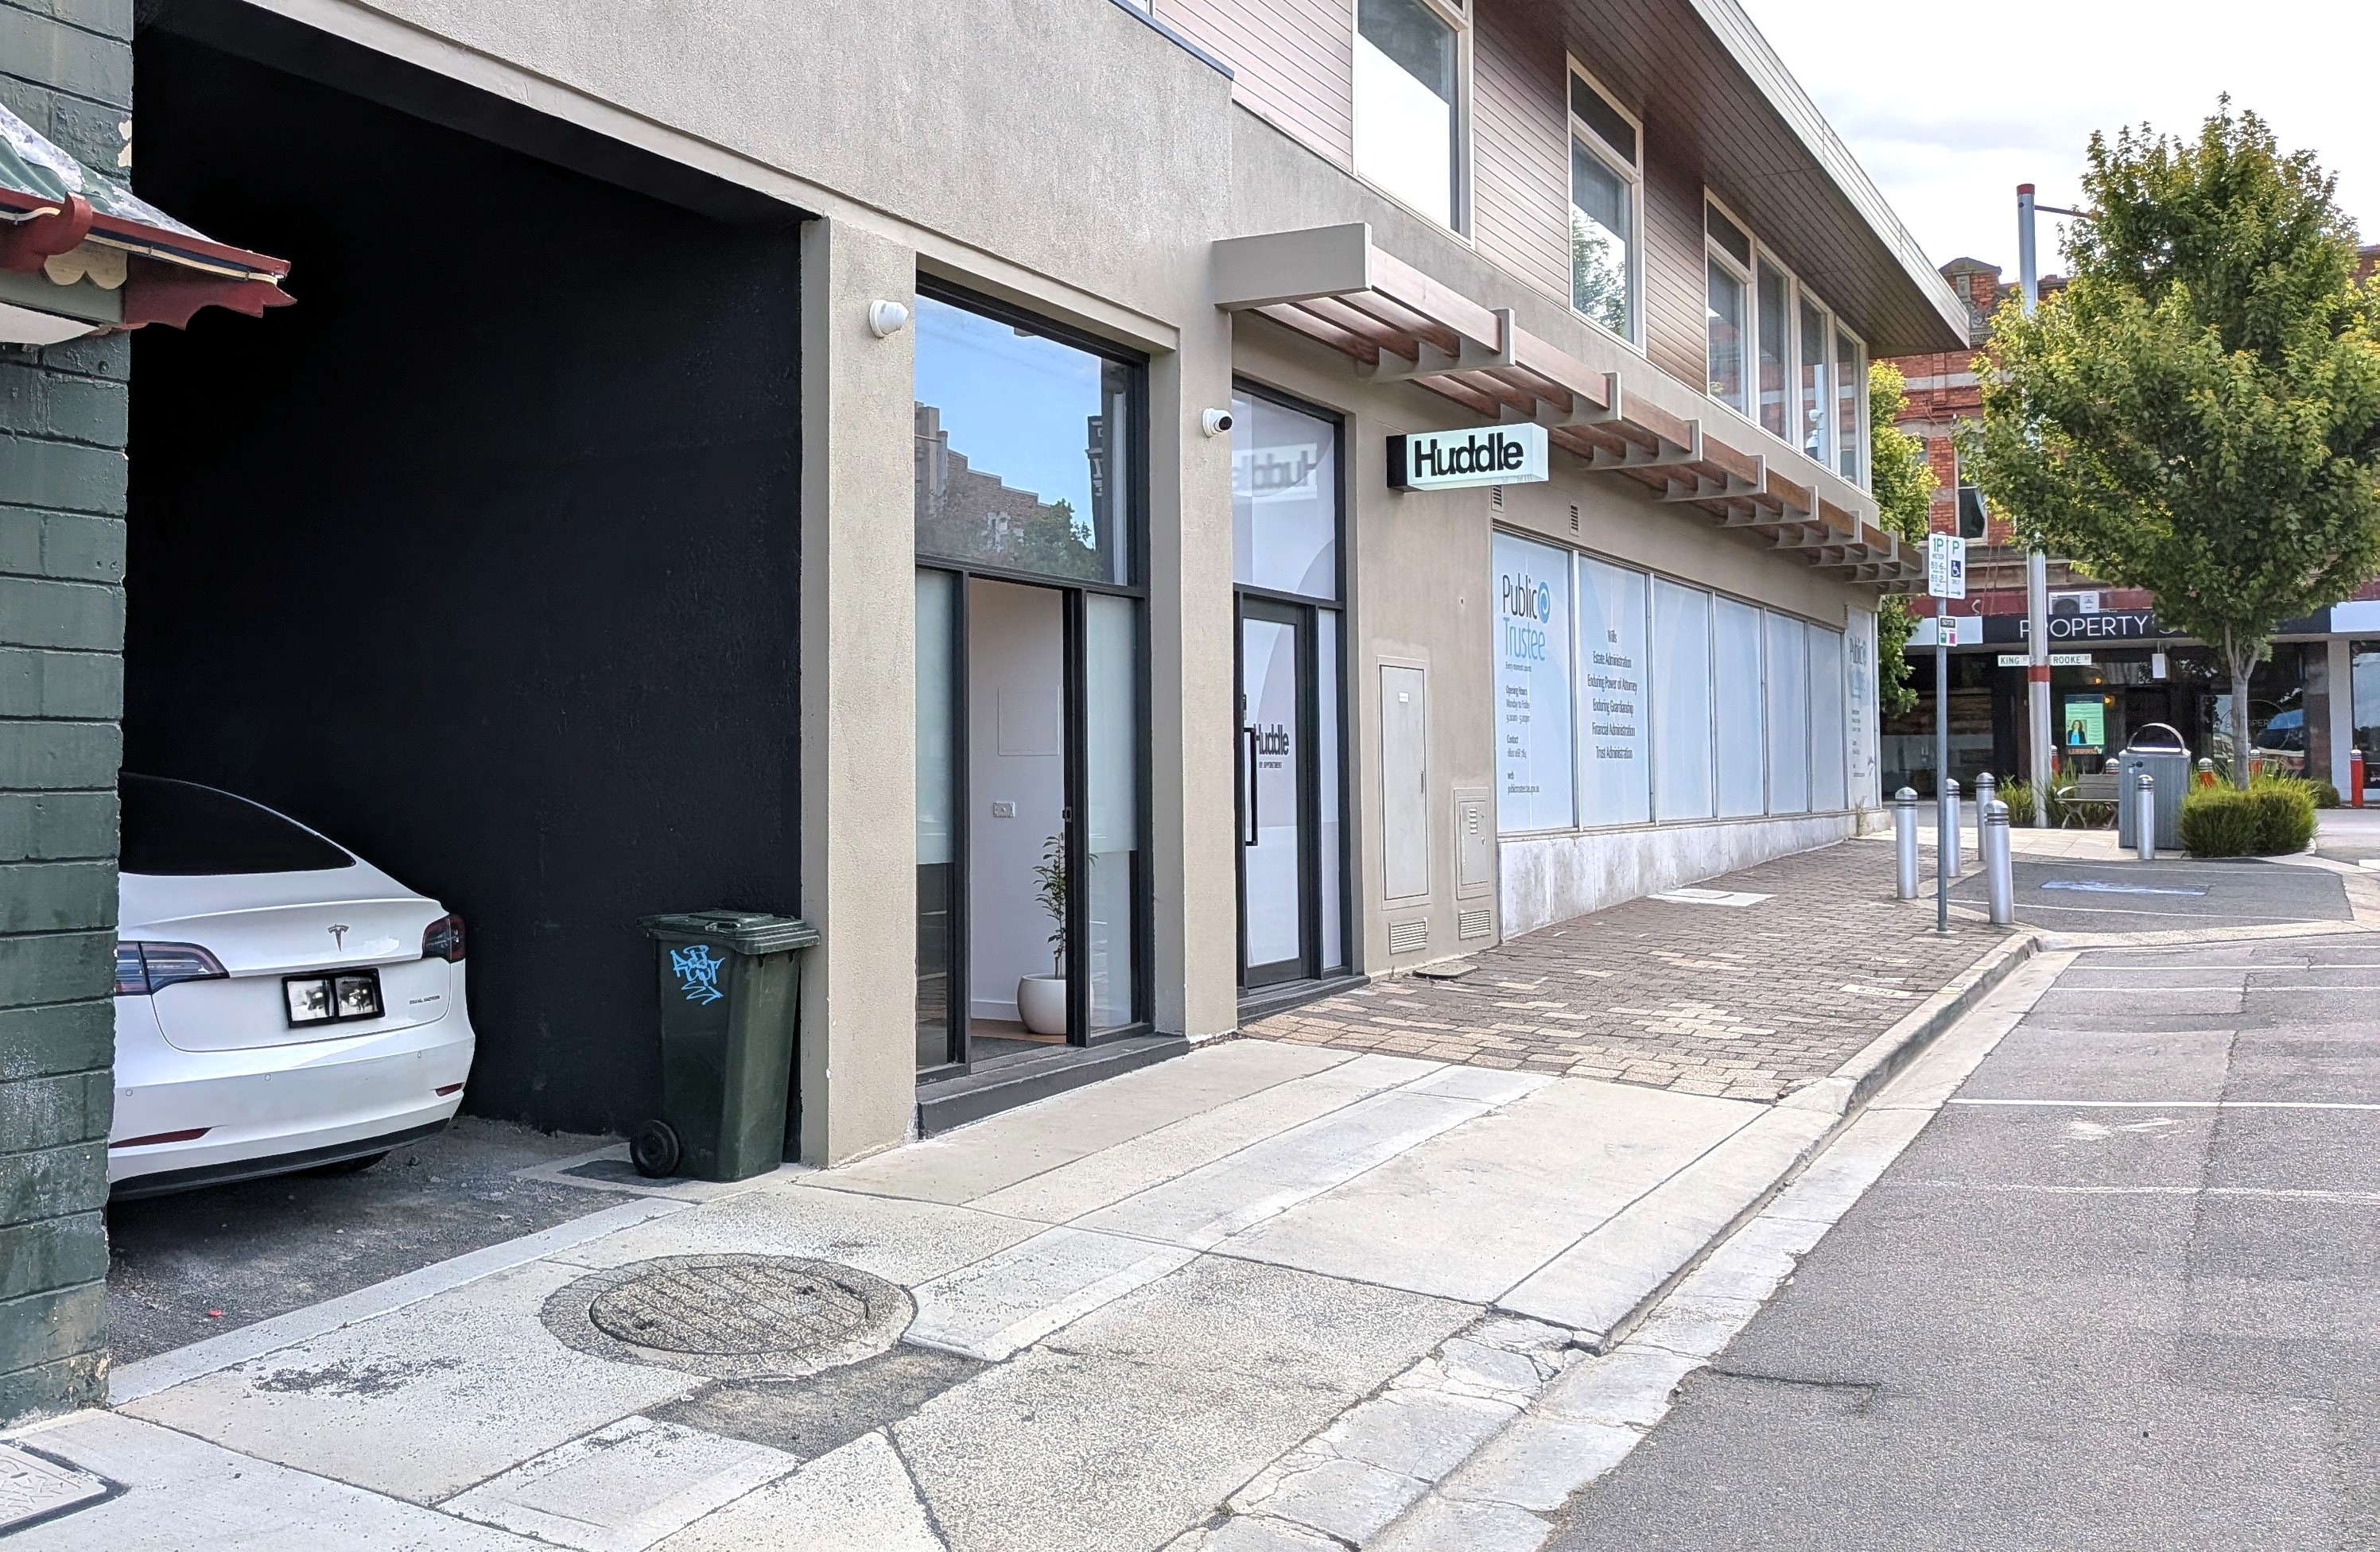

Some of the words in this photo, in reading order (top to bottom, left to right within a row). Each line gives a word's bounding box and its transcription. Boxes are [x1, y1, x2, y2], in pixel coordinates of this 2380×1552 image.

[1414, 432, 1524, 479] Huddle
[1932, 537, 1944, 553] 1P
[1952, 540, 1960, 555] P
[1503, 572, 1537, 619] Public
[2020, 615, 2149, 638] POPERTY
[1503, 616, 1545, 661] Trustee
[1605, 652, 1632, 669] Administration
[1587, 673, 1605, 692] Enduring
[1605, 676, 1617, 689] Power
[1593, 698, 1609, 716] Enduring
[1592, 722, 1609, 735] Financial
[1609, 722, 1636, 737] Administration
[1253, 723, 1290, 756] Huddle
[1606, 745, 1633, 759] Administration
